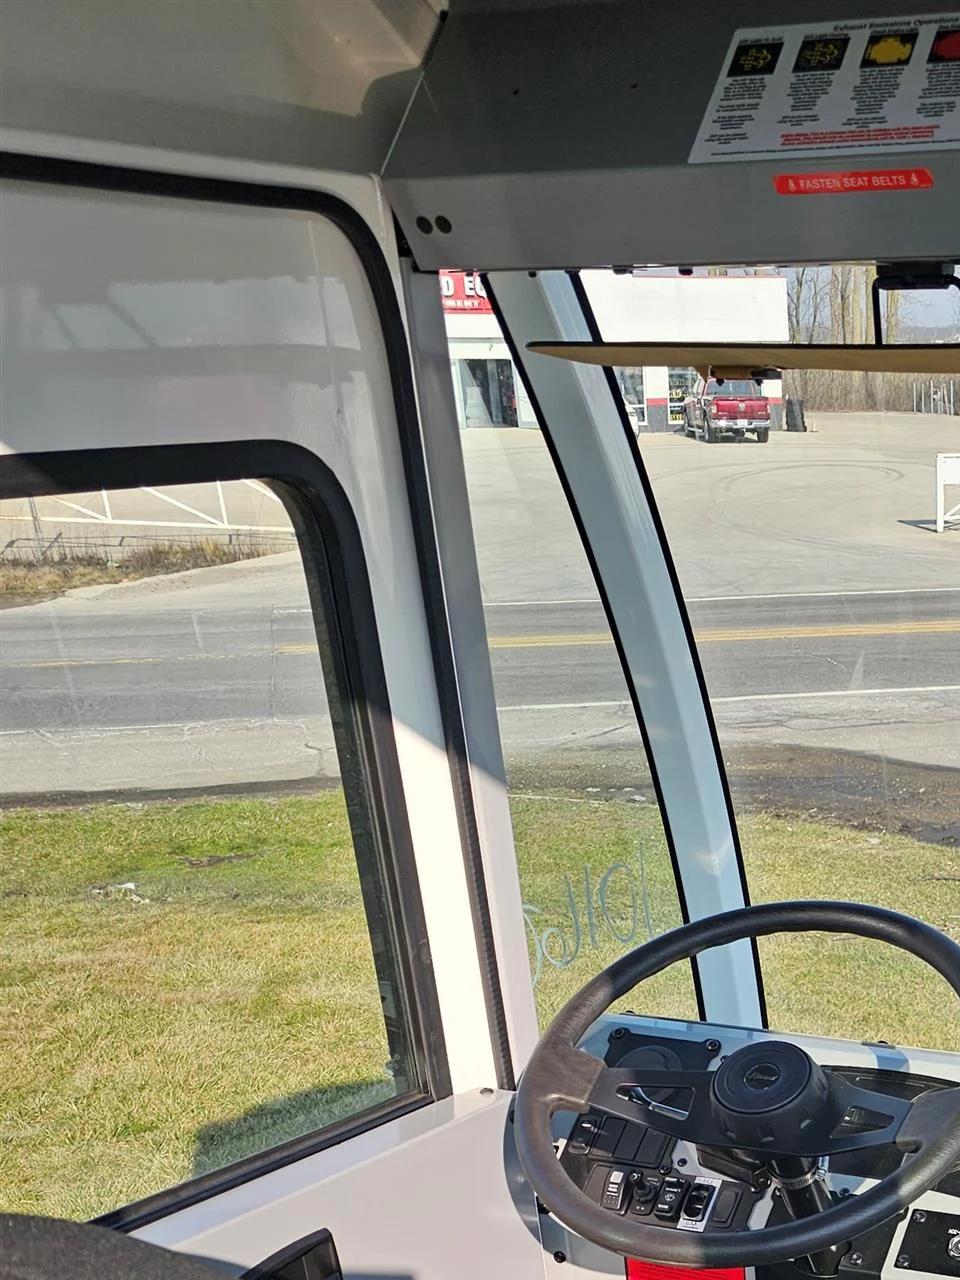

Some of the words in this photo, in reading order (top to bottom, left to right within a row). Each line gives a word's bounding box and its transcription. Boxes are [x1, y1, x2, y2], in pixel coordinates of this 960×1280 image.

[799, 179, 841, 189] FASTEN
[843, 177, 869, 187] SEAT
[872, 175, 906, 186] BELTS
